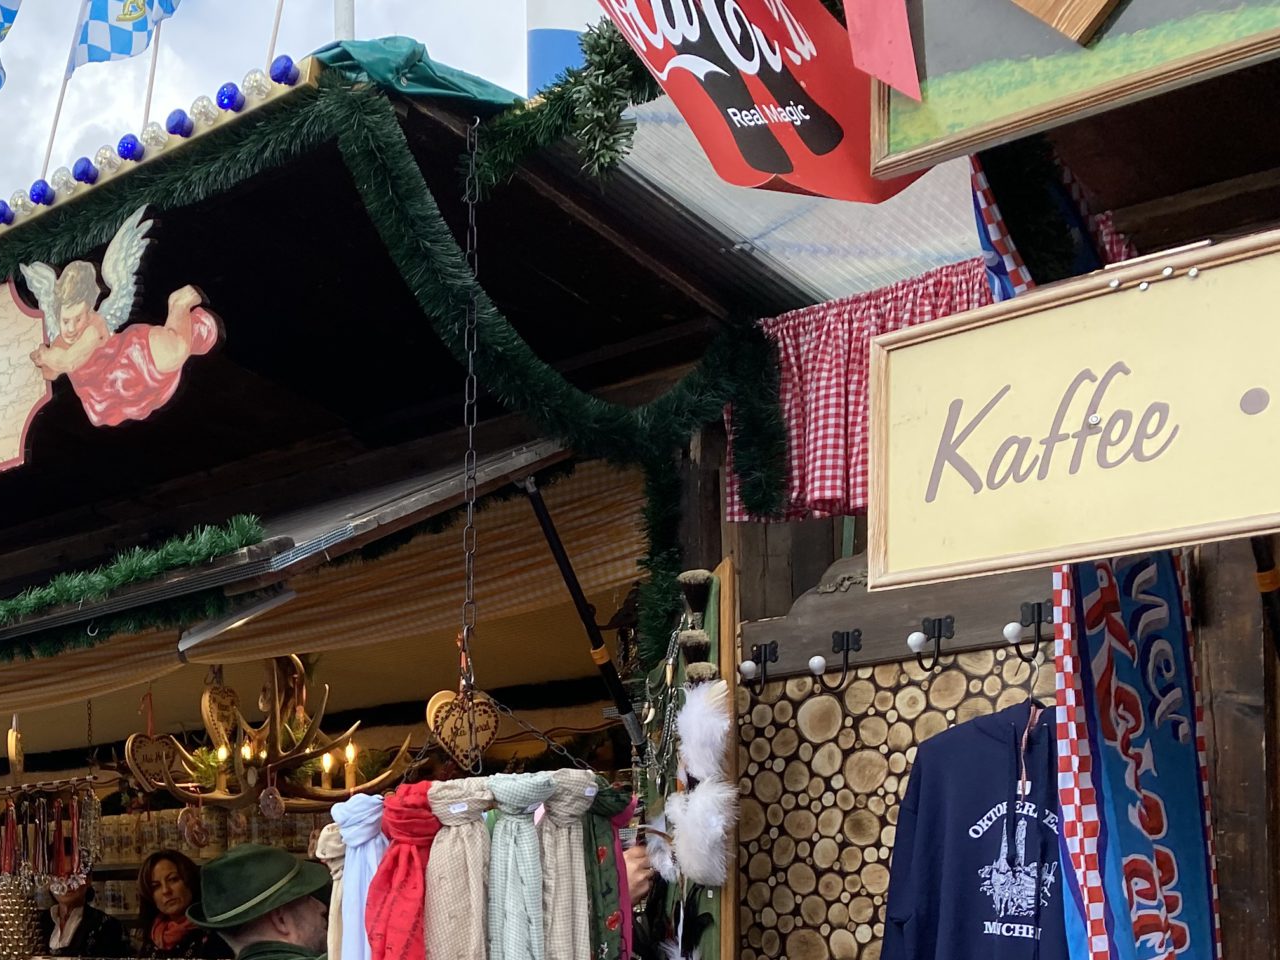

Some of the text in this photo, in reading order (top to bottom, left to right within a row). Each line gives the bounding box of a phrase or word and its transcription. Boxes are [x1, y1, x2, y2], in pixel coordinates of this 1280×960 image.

[727, 100, 810, 128] Real Magic
[925, 361, 1179, 503] Kaffee
